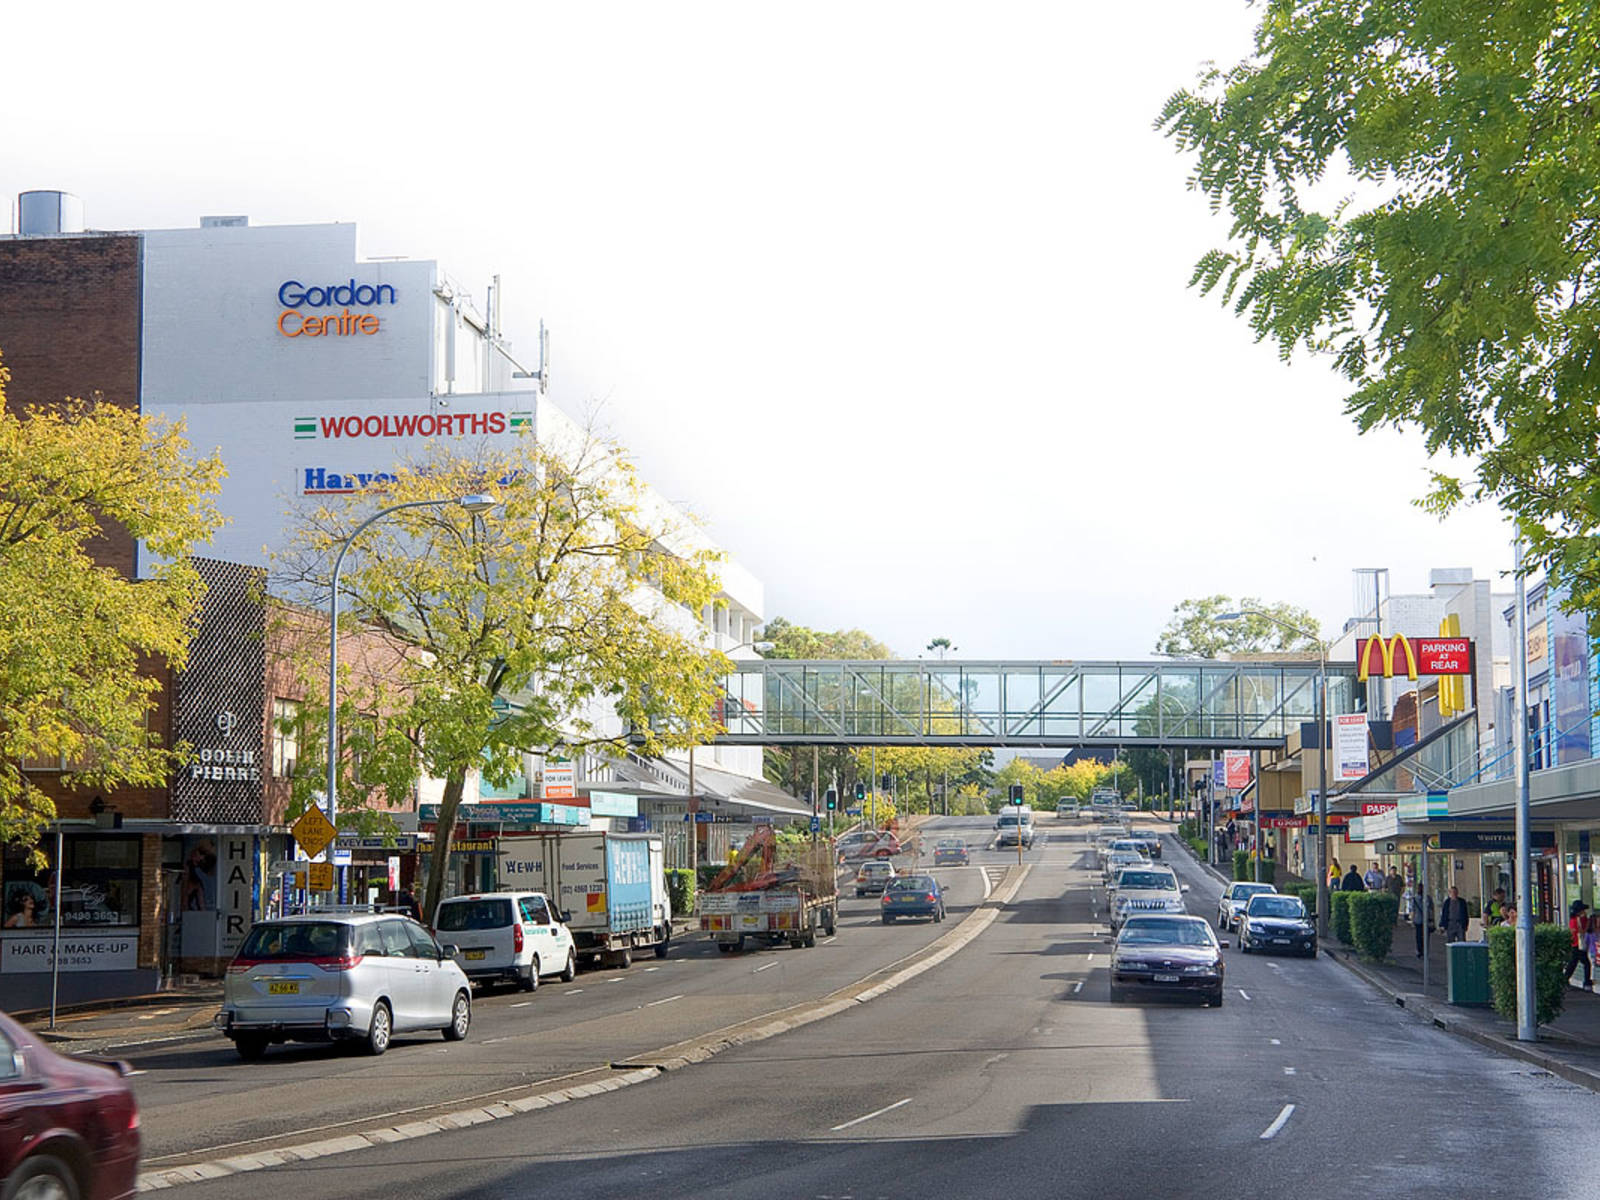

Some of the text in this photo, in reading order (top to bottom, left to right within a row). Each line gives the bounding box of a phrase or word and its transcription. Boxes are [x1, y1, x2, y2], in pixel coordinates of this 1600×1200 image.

[278, 279, 394, 308] Gordon
[277, 309, 380, 337] Centre
[321, 412, 505, 438] WOOLWORTHS
[1422, 643, 1466, 653] PARKING
[1431, 660, 1458, 670] REAR
[191, 765, 260, 781] PIERRE
[304, 817, 323, 825] LEFT
[302, 827, 323, 835] LANE
[302, 837, 323, 845] ENDS
[1477, 833, 1515, 842] WHITTAK
[449, 838, 494, 851] staurant
[562, 863, 575, 871] Food
[576, 862, 599, 871] Services
[227, 841, 247, 934] HAIR
[12, 944, 46, 955] HAIR
[65, 943, 129, 954] MAKE-UP
